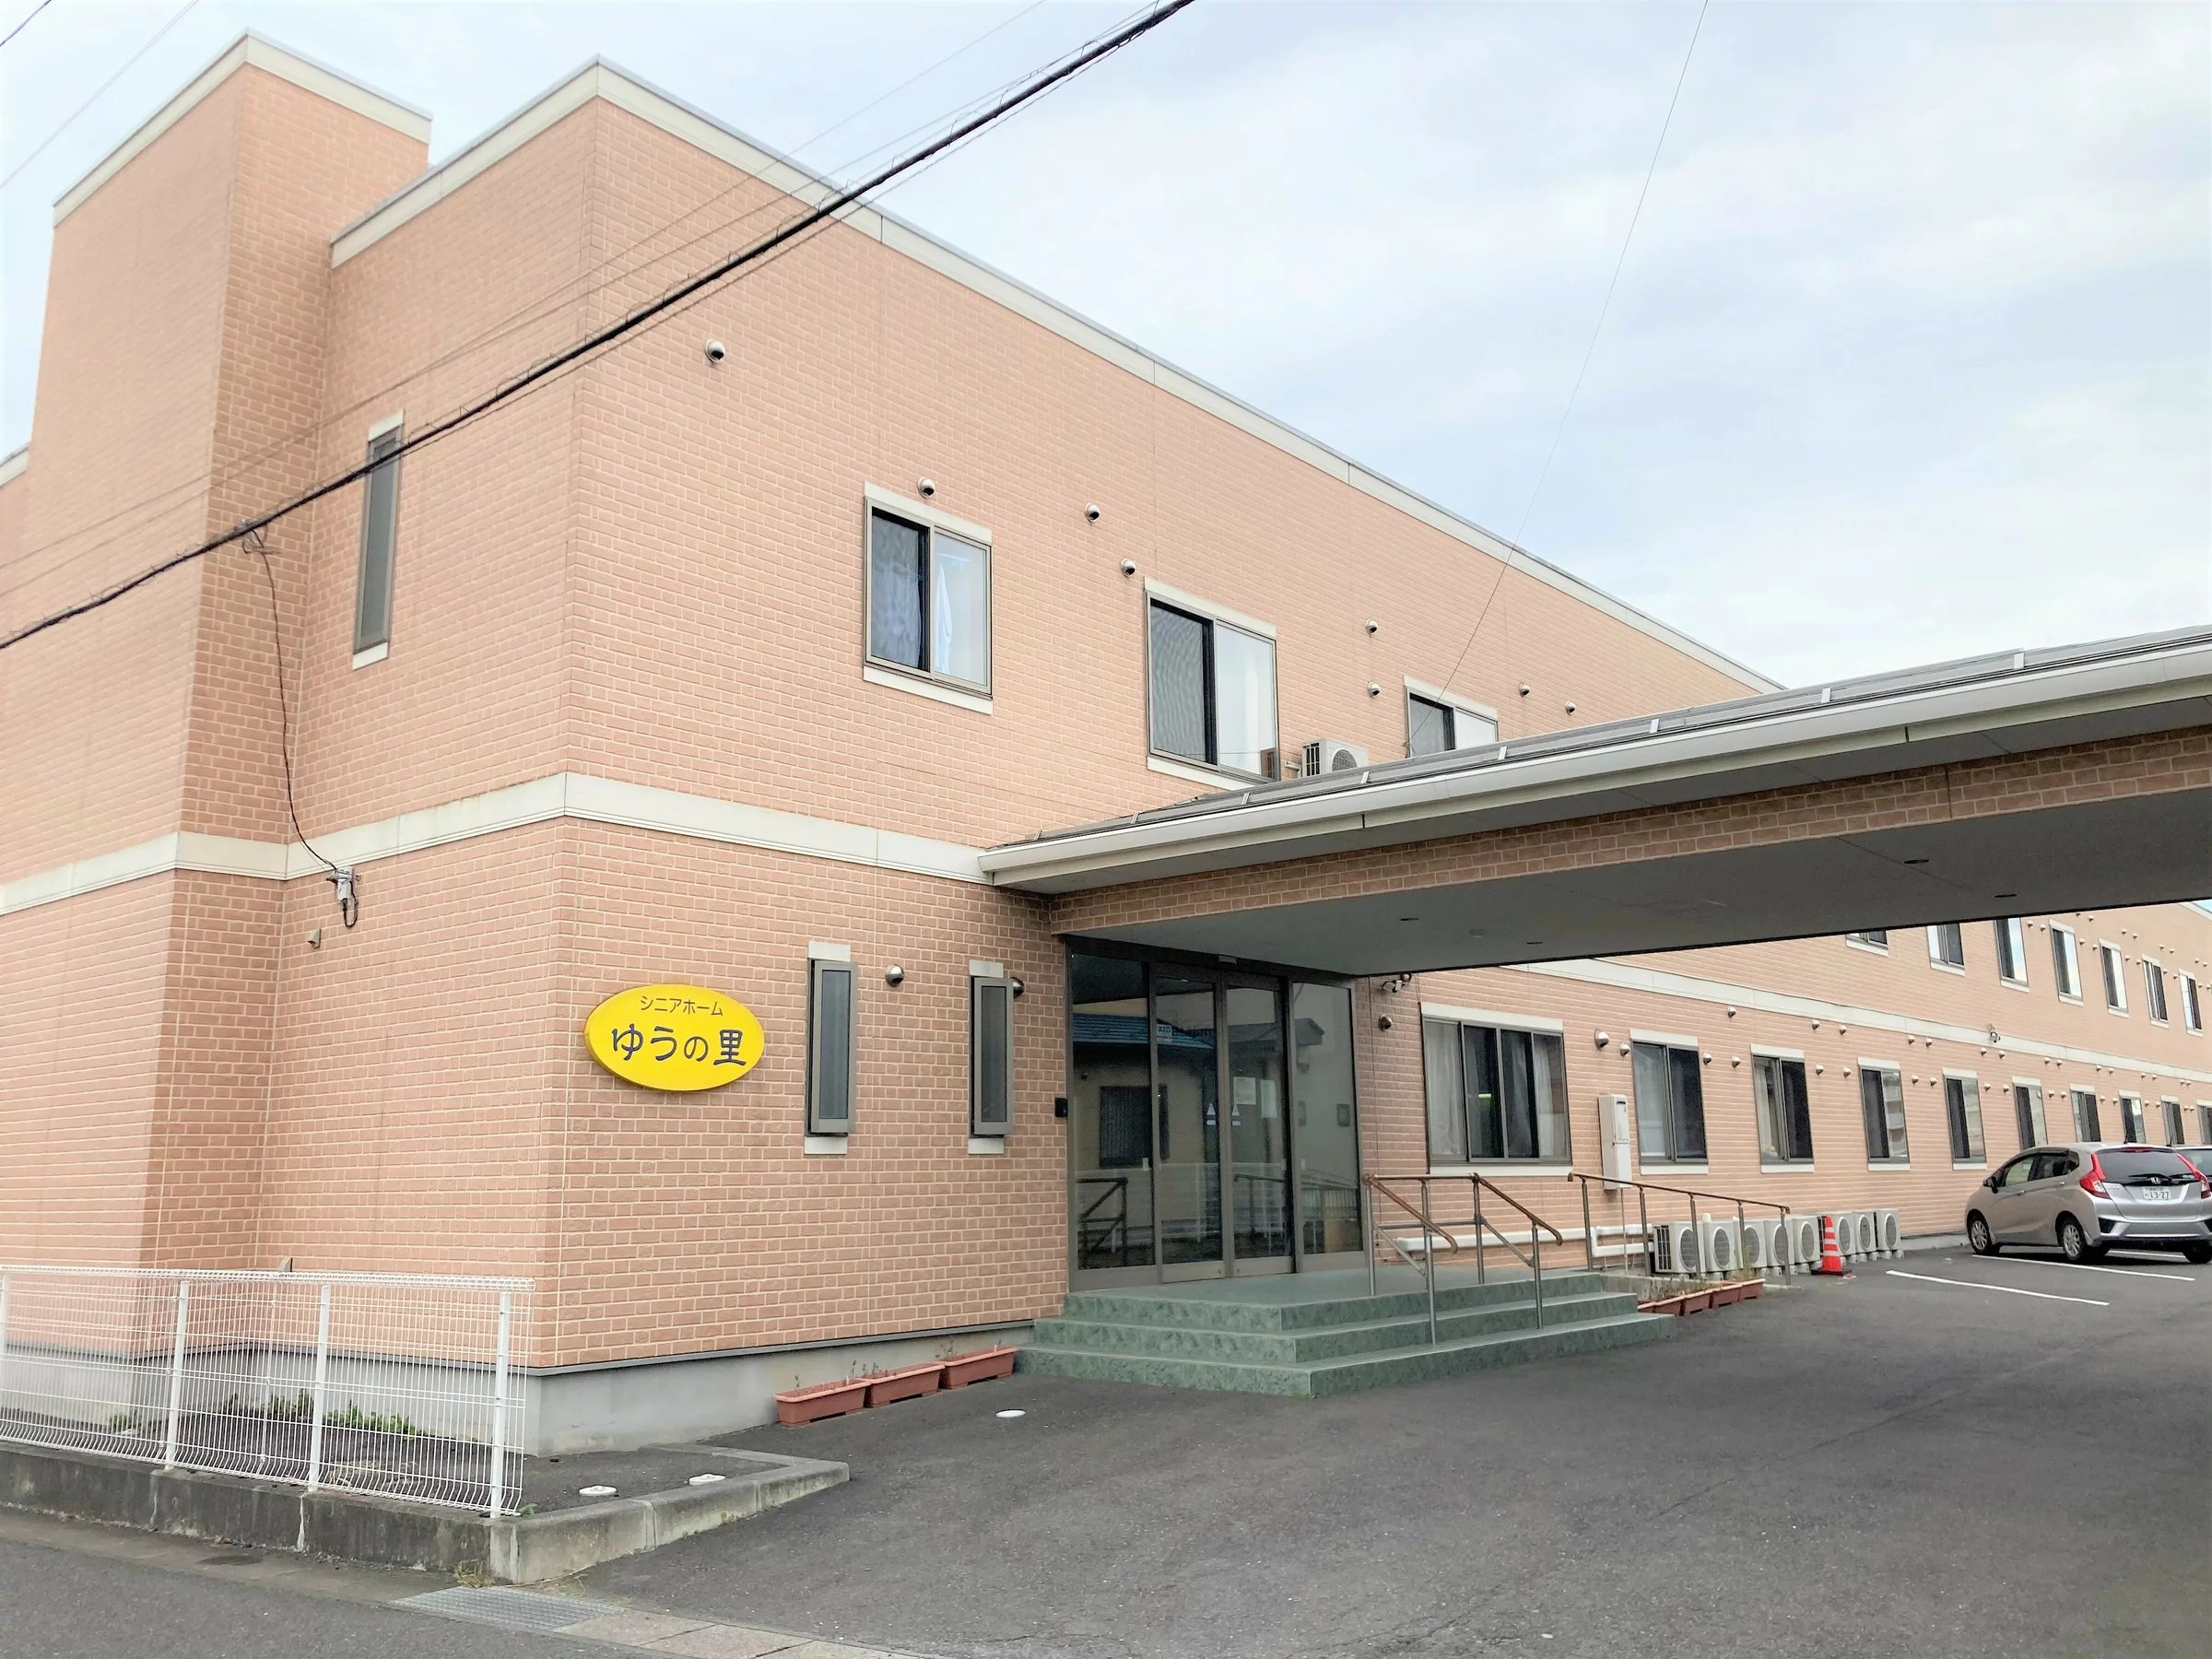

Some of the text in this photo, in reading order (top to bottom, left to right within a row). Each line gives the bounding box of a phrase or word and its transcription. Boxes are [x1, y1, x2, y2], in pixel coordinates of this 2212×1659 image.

[640, 995, 724, 1017] シニアホーム
[611, 1023, 747, 1066] ゆうの里
